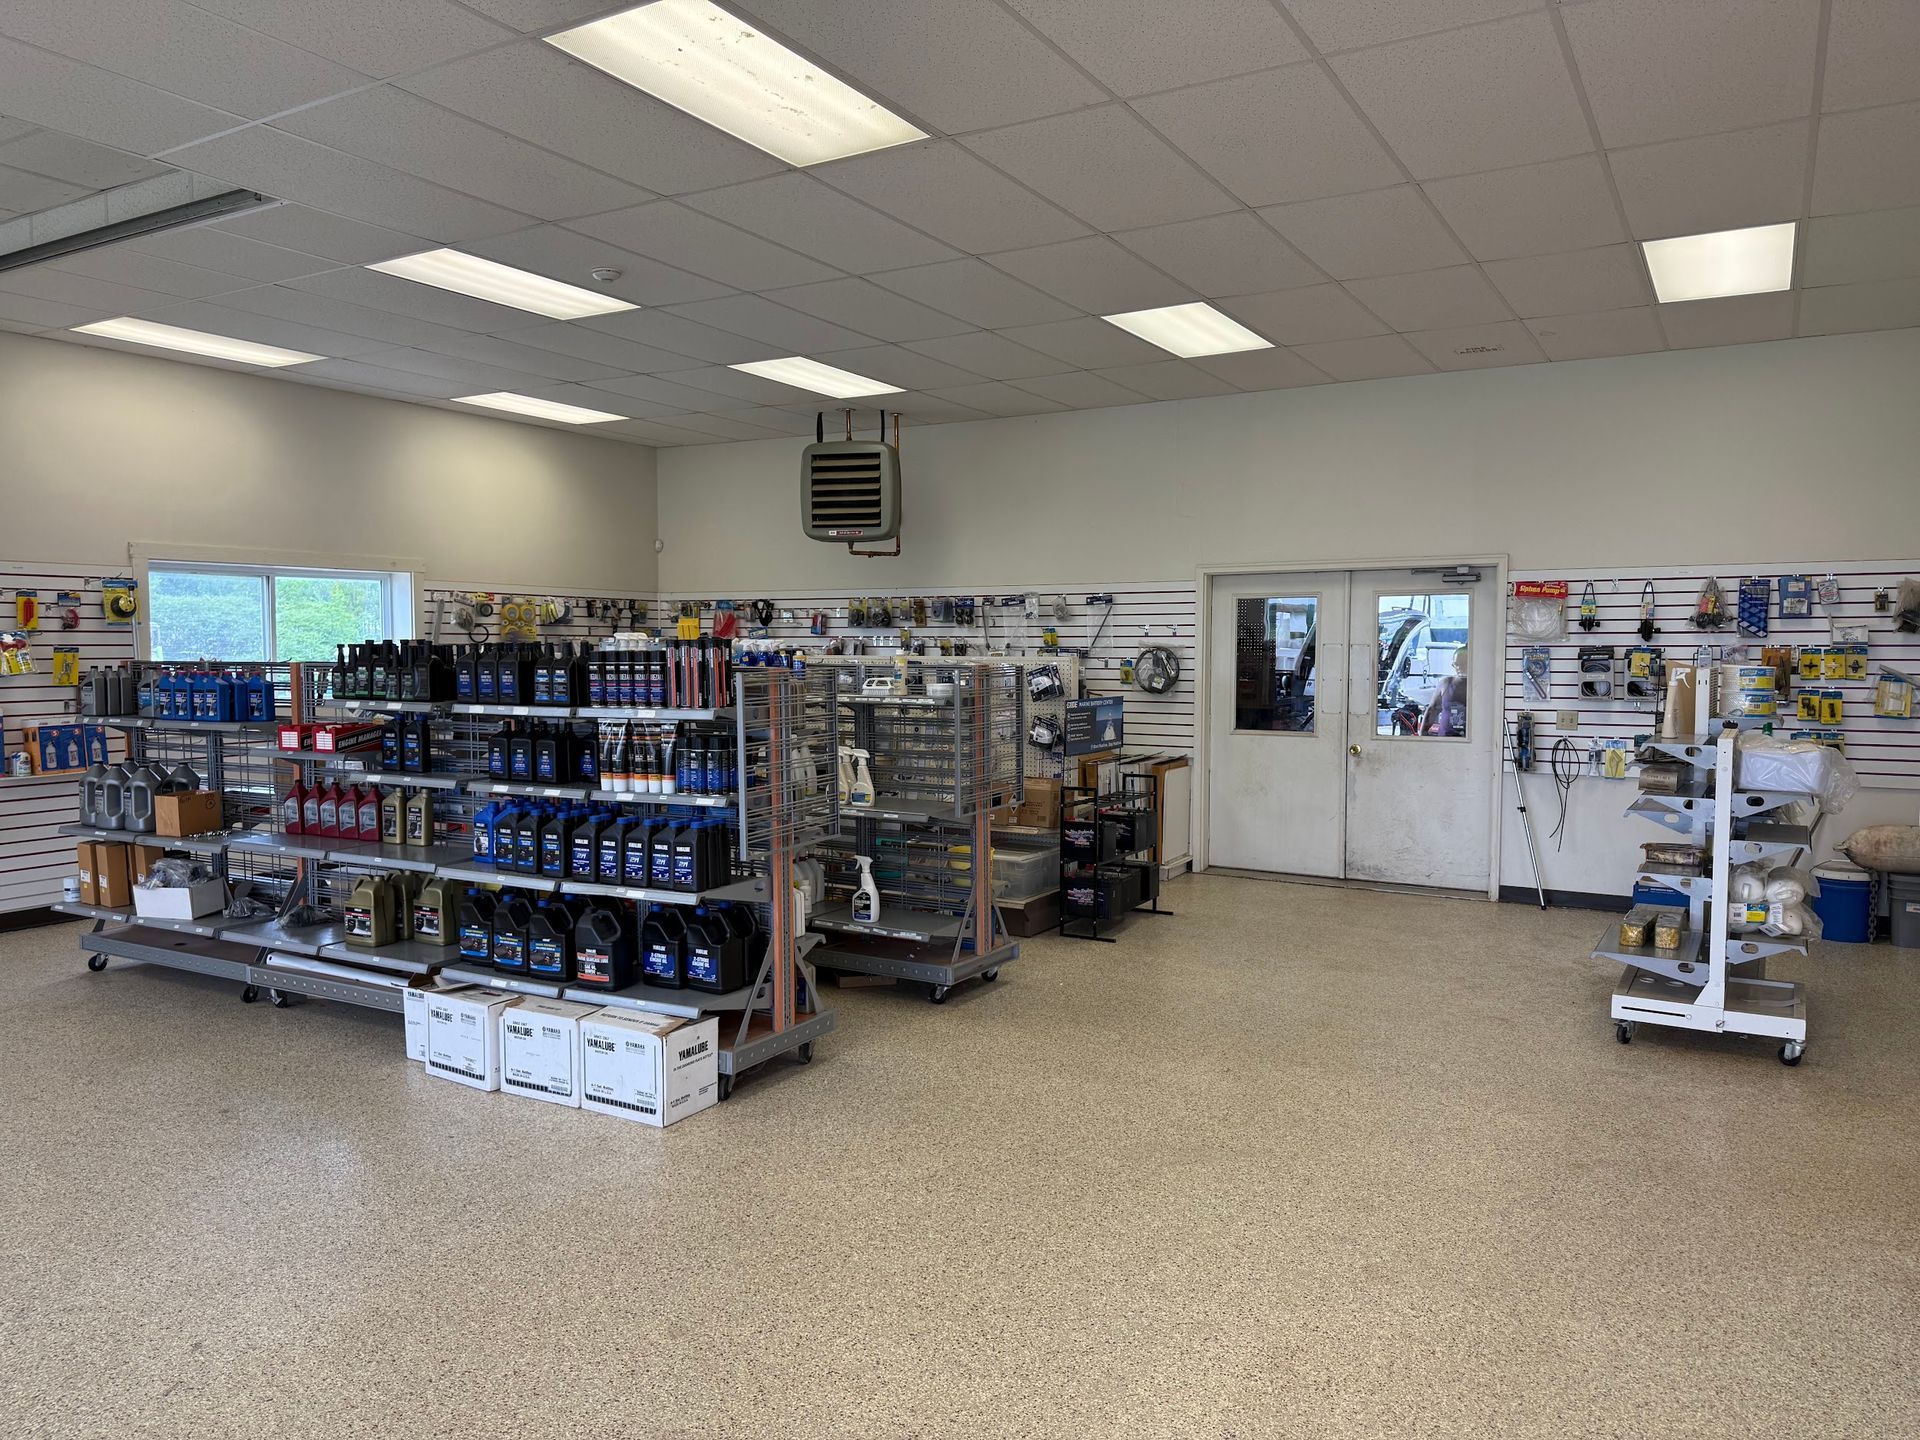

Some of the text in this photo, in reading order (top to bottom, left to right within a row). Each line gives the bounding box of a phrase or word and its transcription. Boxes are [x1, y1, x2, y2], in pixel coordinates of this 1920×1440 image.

[1542, 586, 1560, 595] Pump
[430, 1009, 453, 1022] YAMALUBE
[507, 1024, 533, 1037] YAMALUBE
[587, 1038, 615, 1052] YAMALUBE
[678, 1040, 709, 1061] YAMALUBE
